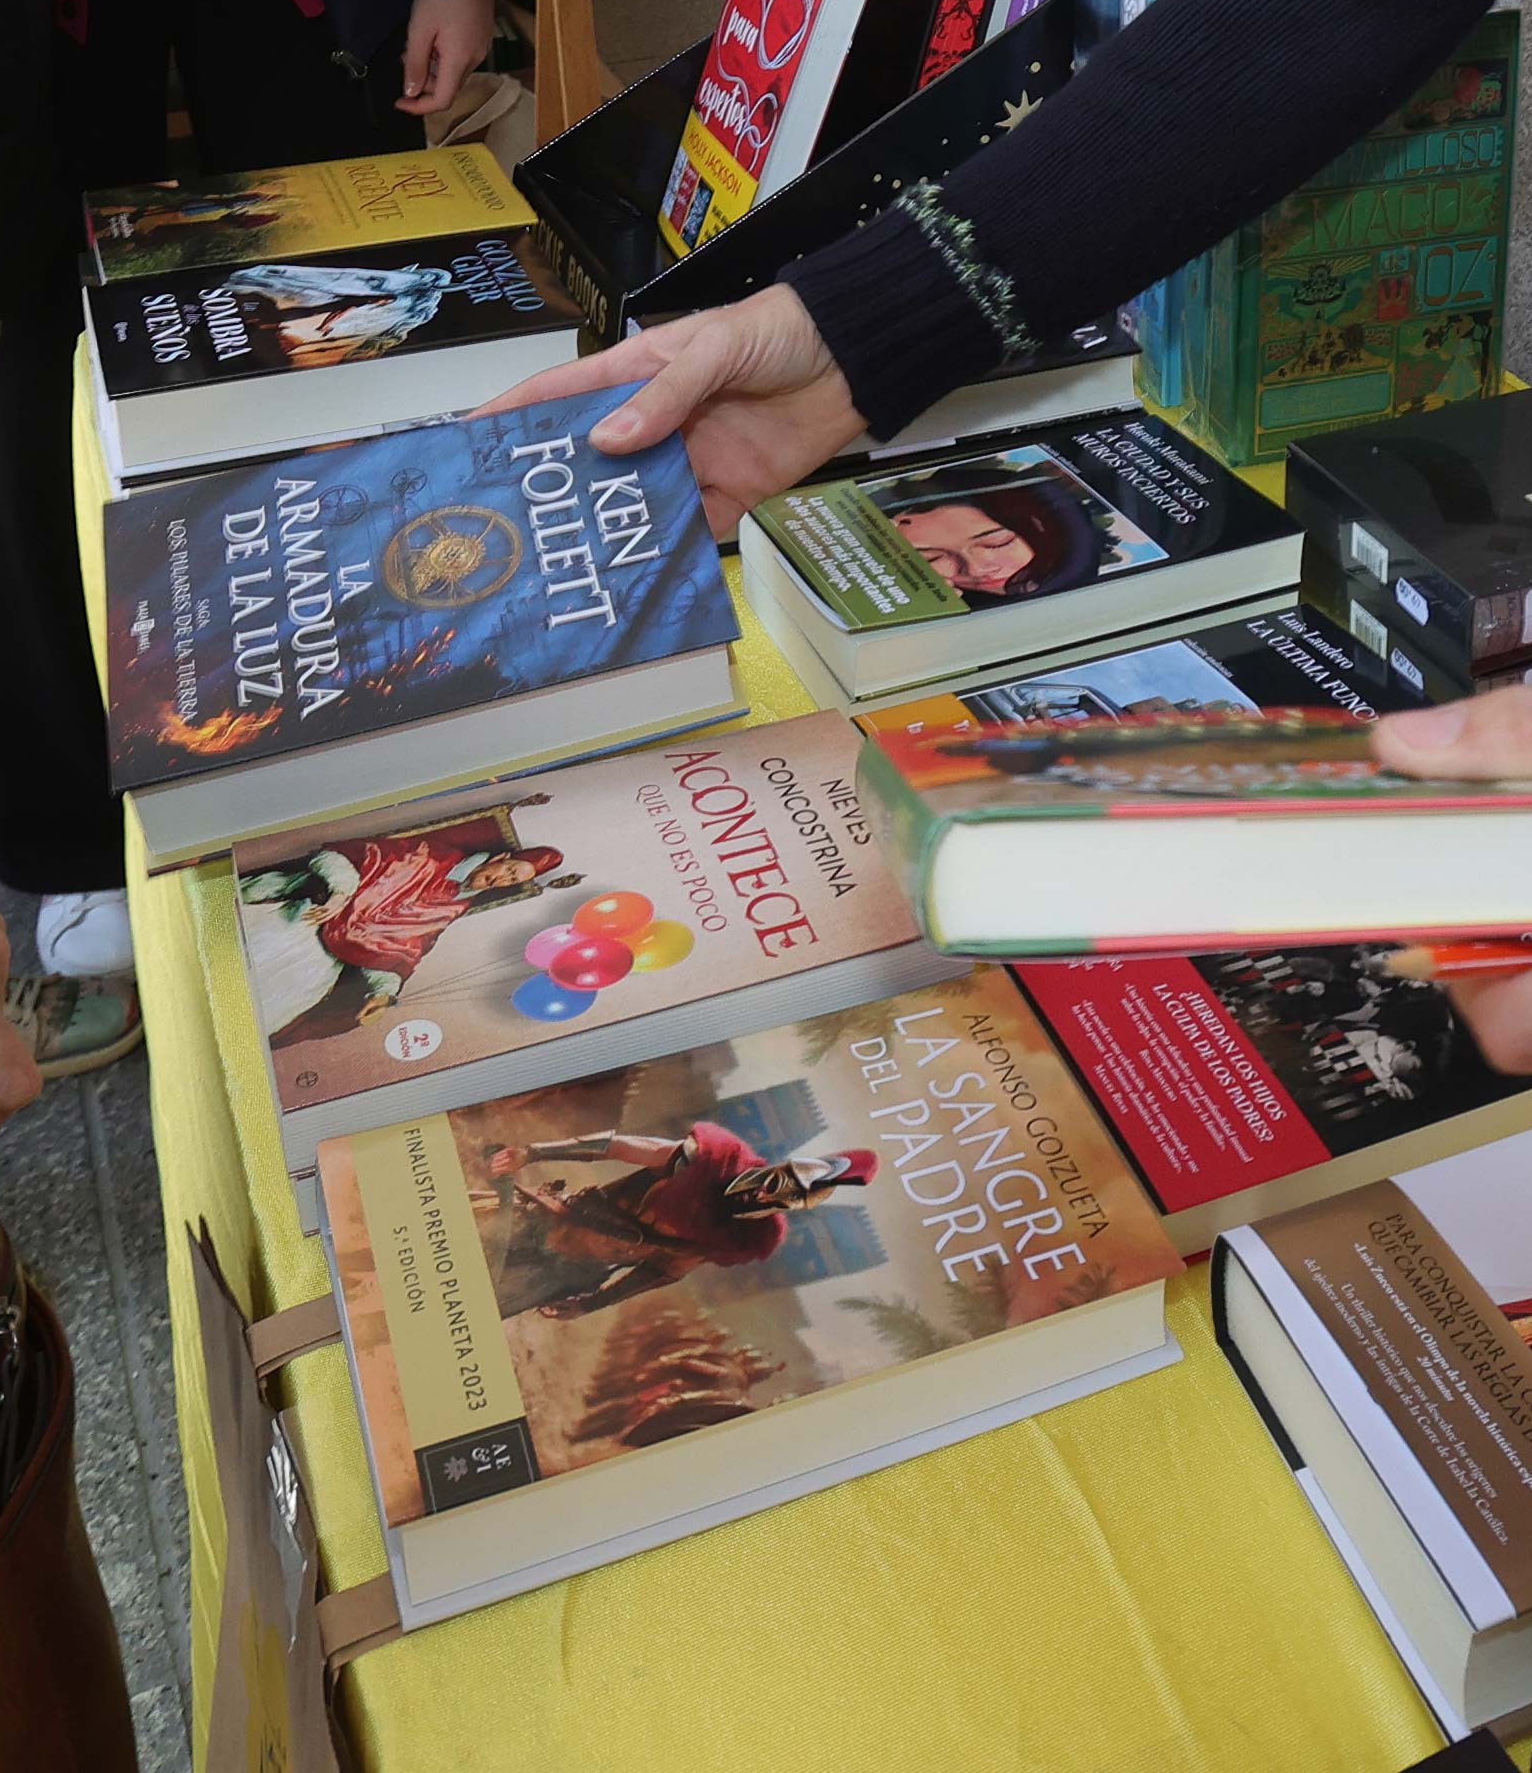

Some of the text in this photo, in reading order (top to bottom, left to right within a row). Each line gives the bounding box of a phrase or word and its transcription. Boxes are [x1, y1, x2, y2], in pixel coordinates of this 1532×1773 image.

[721, 6, 760, 55] para
[698, 77, 752, 136] expertos
[702, 147, 744, 198] JACKSON
[1312, 179, 1462, 252] MAGO
[447, 254, 505, 304] GINER
[472, 238, 548, 314] GONZALO
[567, 254, 609, 336] BOOKS
[1424, 236, 1496, 310] OZ
[137, 291, 200, 365] SUEÑOS
[195, 285, 254, 361] SOMBRA
[1071, 433, 1129, 468] MUROS
[1114, 466, 1198, 523] INCIERTOS
[1093, 427, 1212, 509] LA CIUDAD Y SUS
[1120, 421, 1216, 485] Haruki Murakami
[507, 432, 618, 641] FOLLETT
[582, 469, 665, 569] KEN
[782, 518, 808, 530] de
[790, 528, 834, 559] nuestro
[800, 515, 842, 545] autores
[805, 496, 914, 605] La nueva gran novela de uno
[826, 543, 858, 562] más
[195, 598, 210, 627] SAGA
[220, 505, 286, 708] DE LA LUZ
[272, 469, 347, 720] ARMADURA
[335, 559, 375, 602] LA
[836, 561, 903, 614] importantes
[167, 518, 199, 724] LOS PILARES DE LA TIERRA
[1242, 619, 1280, 638] LA
[1263, 635, 1334, 682] ÚLTIMA
[1274, 611, 1313, 633] Luis
[1297, 630, 1360, 670] Landero
[758, 754, 858, 898] CONCOSTRINA
[819, 777, 874, 847] NIEVES
[634, 782, 729, 934] QUE NO ES POCO
[664, 742, 820, 960] ACONTECE
[1149, 983, 1276, 1143] LA CULPA DE LOS PADRES?
[1176, 991, 1289, 1122] ¿HEREDAN LOS HIJOS
[847, 1035, 1012, 1285] DEL PADRE
[890, 1005, 1087, 1283] LA SANGRE
[960, 1008, 1117, 1240] ALFONSO GOIZUETA
[395, 1245, 430, 1314] EDICIÓN
[400, 1126, 490, 1413] FINALISTA PREMIO PLANETA 2023
[1384, 1212, 1428, 1255] PARA
[1413, 1253, 1508, 1363] CONQUISTAR
[1499, 1361, 1527, 1388] LA
[1363, 1220, 1403, 1257] QUE
[1390, 1253, 1457, 1330] CAMBIAR
[1448, 1329, 1482, 1363] LAS
[1471, 1359, 1532, 1430] REGLAS
